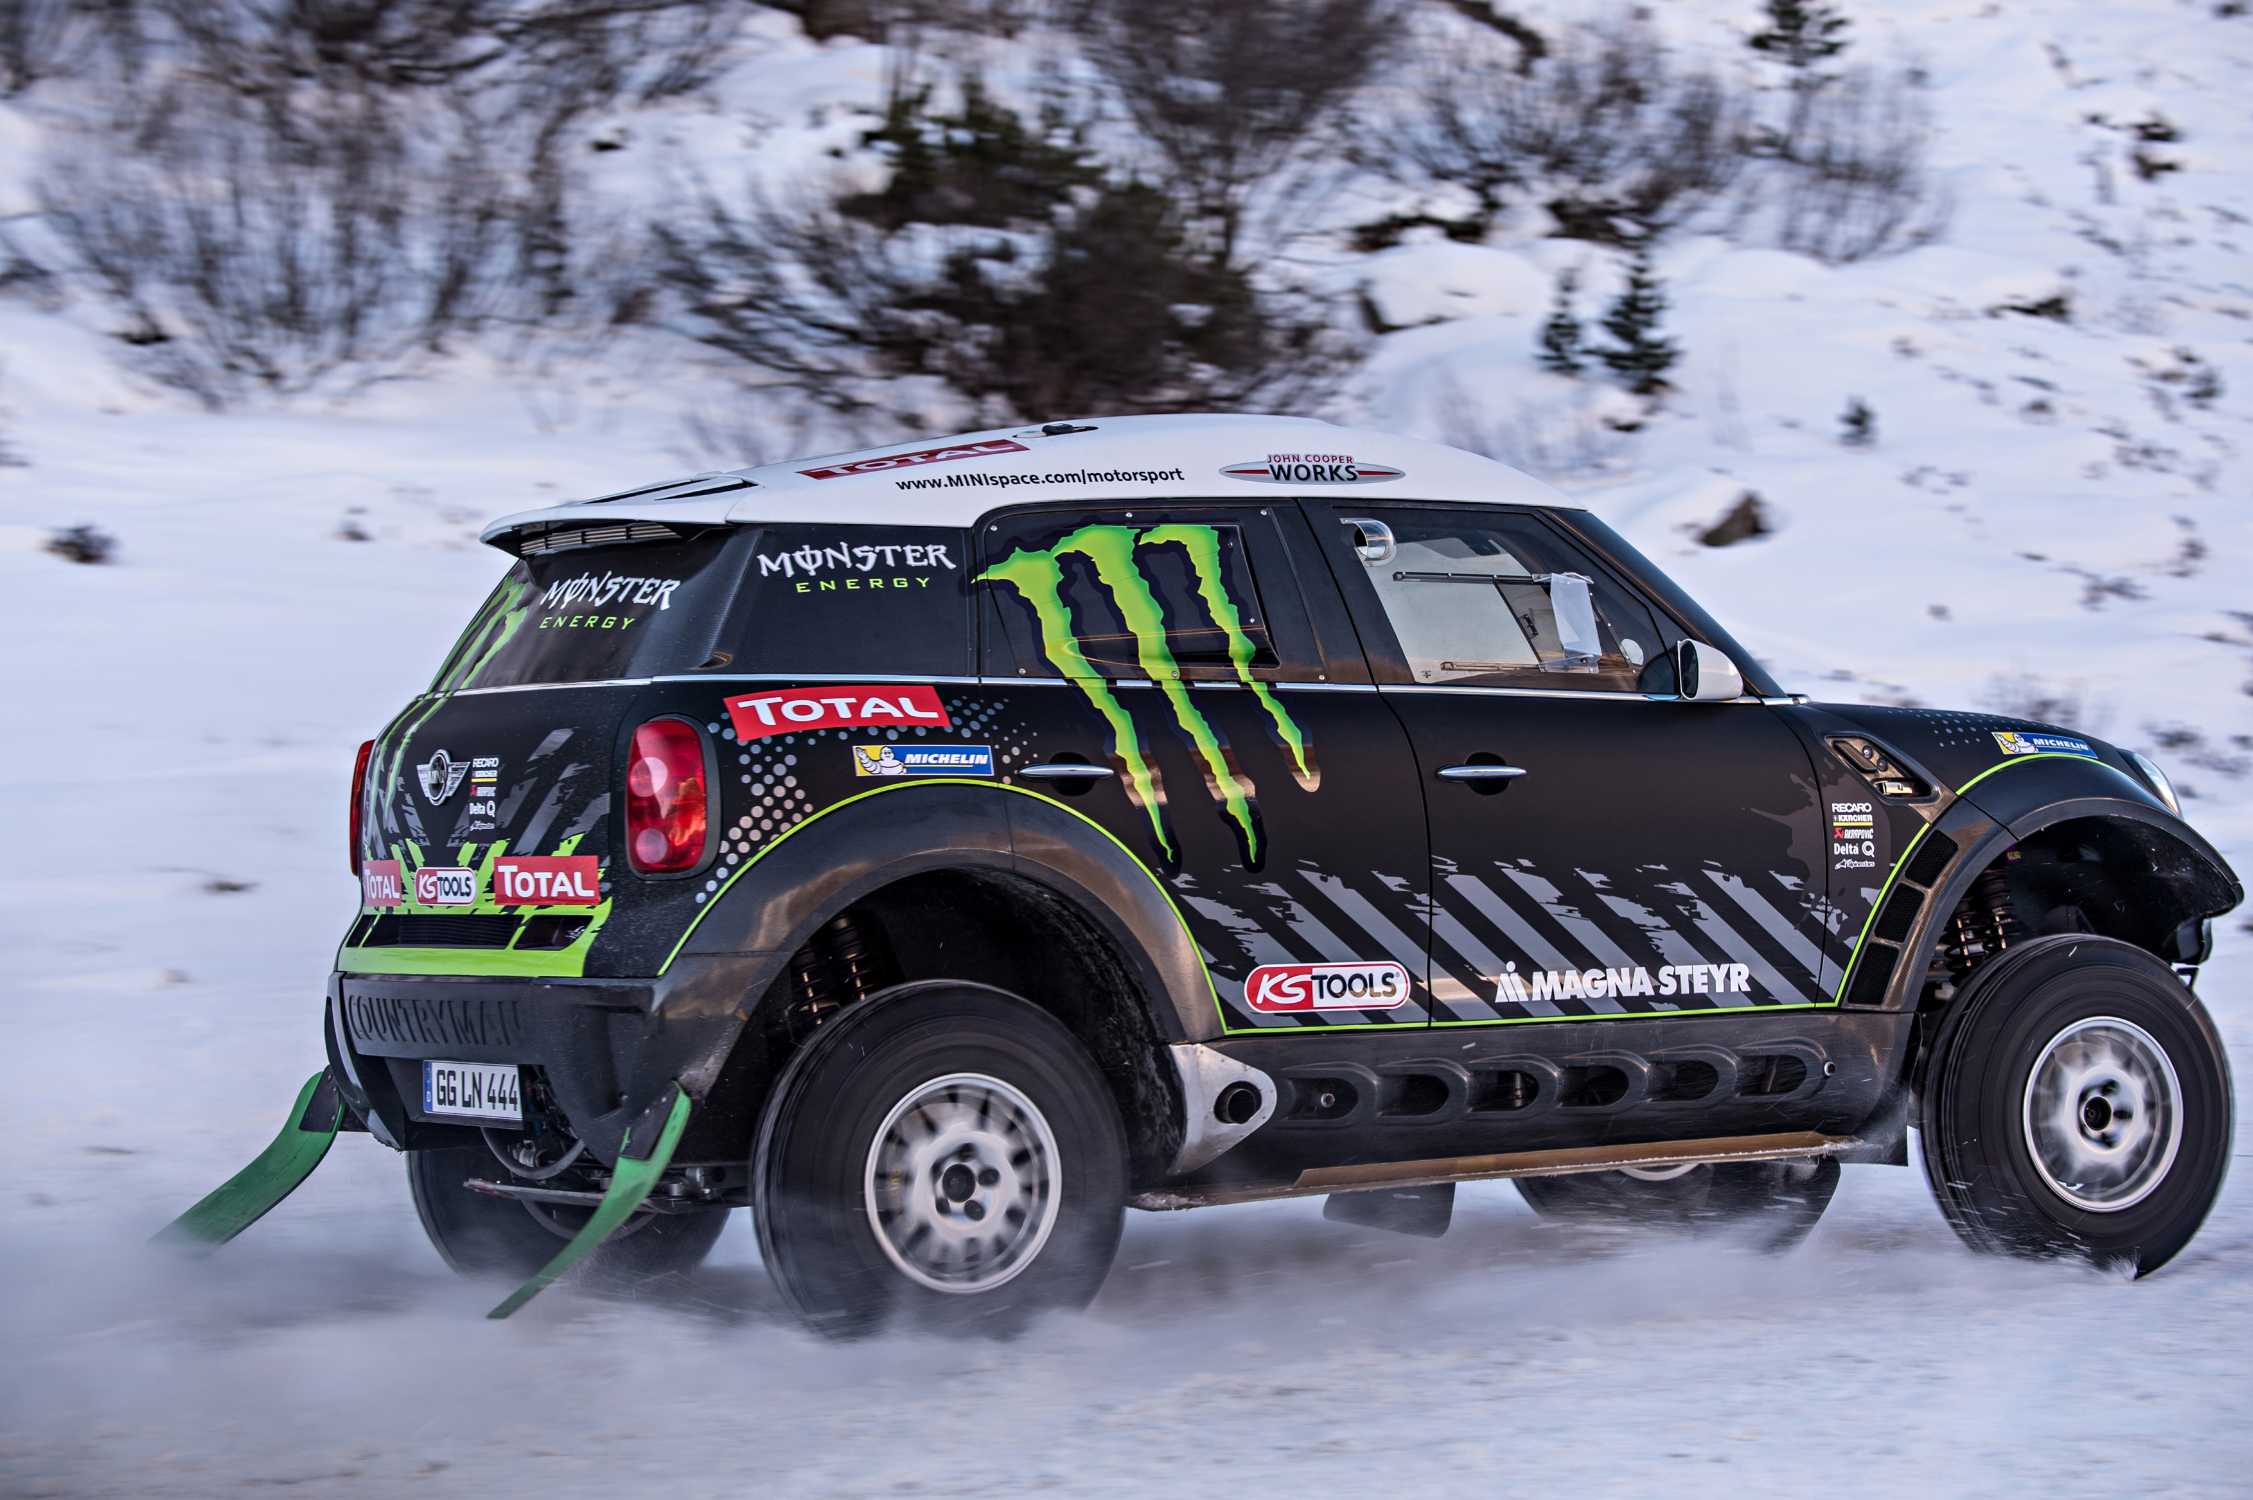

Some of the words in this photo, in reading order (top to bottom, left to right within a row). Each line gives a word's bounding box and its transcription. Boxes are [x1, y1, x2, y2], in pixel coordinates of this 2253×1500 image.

[811, 446, 1016, 474] TOTAL
[1267, 454, 1300, 464] JOHN
[1305, 454, 1353, 464] COOPER
[896, 468, 1185, 490] www.MINIspace.com/motorsport
[1269, 464, 1358, 482] WORKS
[795, 577, 930, 593] ENERGY
[538, 615, 637, 630] ENERGY
[737, 696, 939, 726] TOTAL
[2032, 738, 2089, 751] MICHELIN
[904, 753, 989, 766] MICHELIN
[486, 800, 496, 818] Q
[1831, 802, 1872, 813] RECARO
[1833, 842, 1859, 855] Delta
[1861, 840, 1875, 858] Q
[365, 868, 400, 900] TOTAL
[498, 864, 595, 898] TOTAL
[1531, 966, 1655, 1001] MAGNA
[1658, 963, 1752, 996] STEYR
[436, 1069, 457, 1107] GG
[461, 1071, 483, 1109] LN
[487, 1073, 518, 1112] 444
